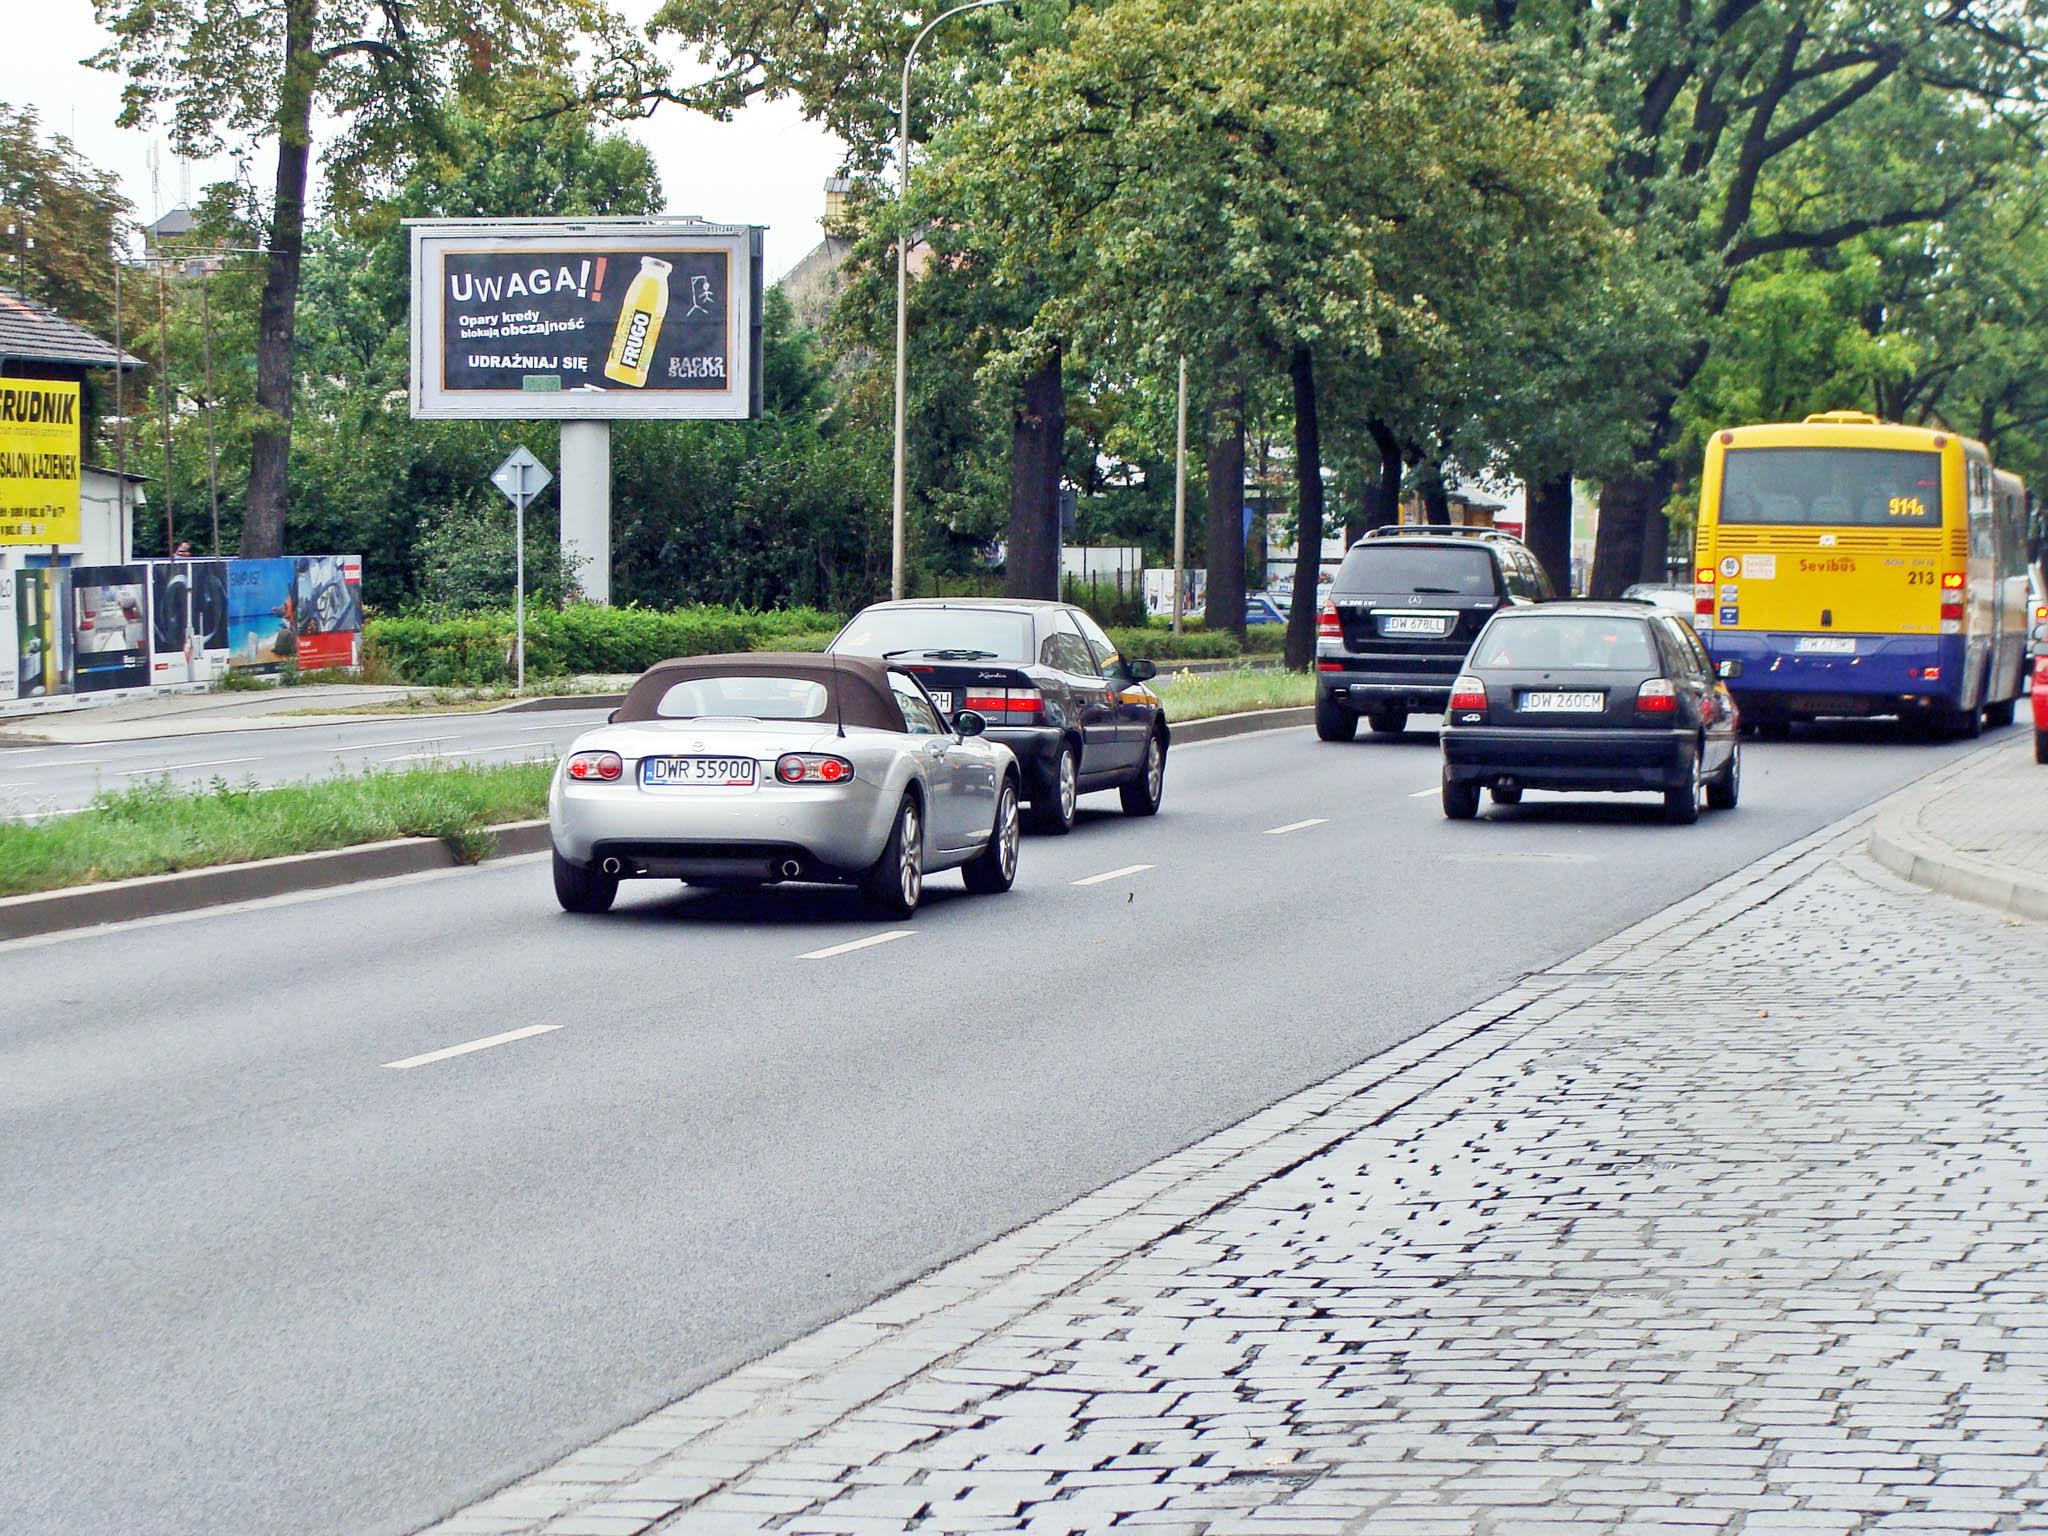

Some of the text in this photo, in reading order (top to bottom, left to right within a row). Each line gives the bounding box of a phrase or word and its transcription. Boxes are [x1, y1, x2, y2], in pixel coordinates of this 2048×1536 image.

[451, 256, 608, 303] UWAGA!!
[459, 310, 540, 328] Opary kredy
[461, 317, 585, 339] blokują obczajność
[621, 312, 651, 368] FRUGO
[562, 356, 588, 372] SIĘ
[670, 356, 724, 369] BACK2
[668, 366, 727, 378] SCHOOL
[1799, 559, 1856, 573] Sevibus
[1908, 571, 1935, 585] 213
[1391, 618, 1442, 632] DW 678LL
[1531, 694, 1600, 708] DW 260CM
[656, 760, 751, 779] DWR 55900
